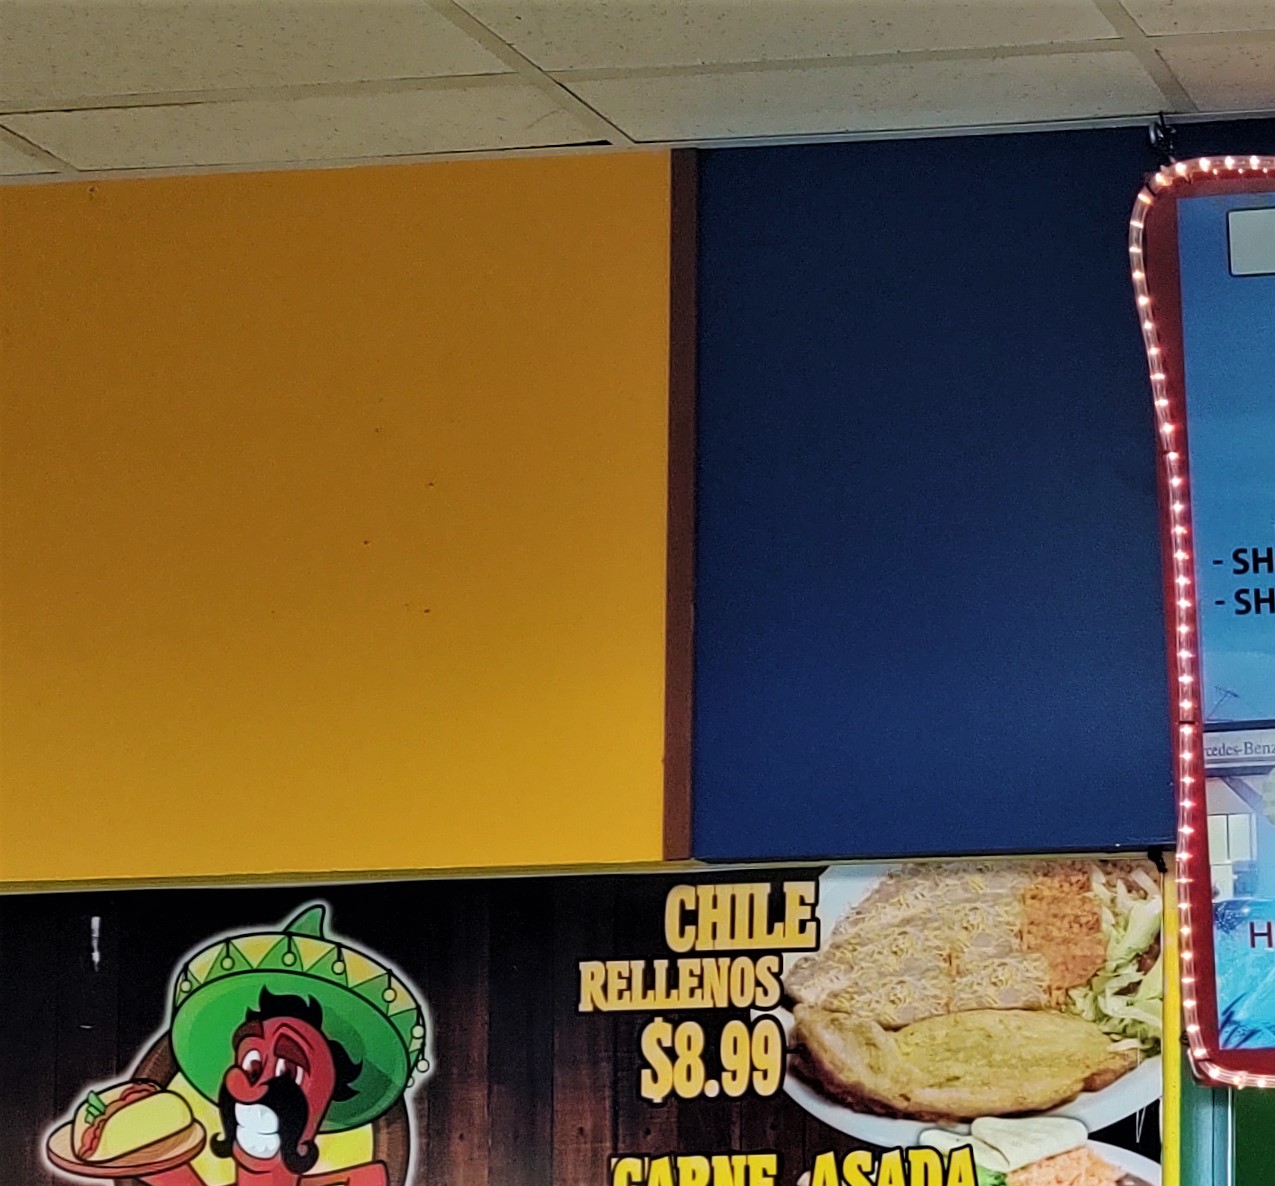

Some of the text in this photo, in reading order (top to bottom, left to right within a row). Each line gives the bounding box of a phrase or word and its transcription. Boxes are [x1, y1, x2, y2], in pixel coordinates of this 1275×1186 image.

[665, 881, 818, 952] CHILE
[578, 956, 780, 1012] RELLENOS
[641, 1017, 782, 1102] $8.99
